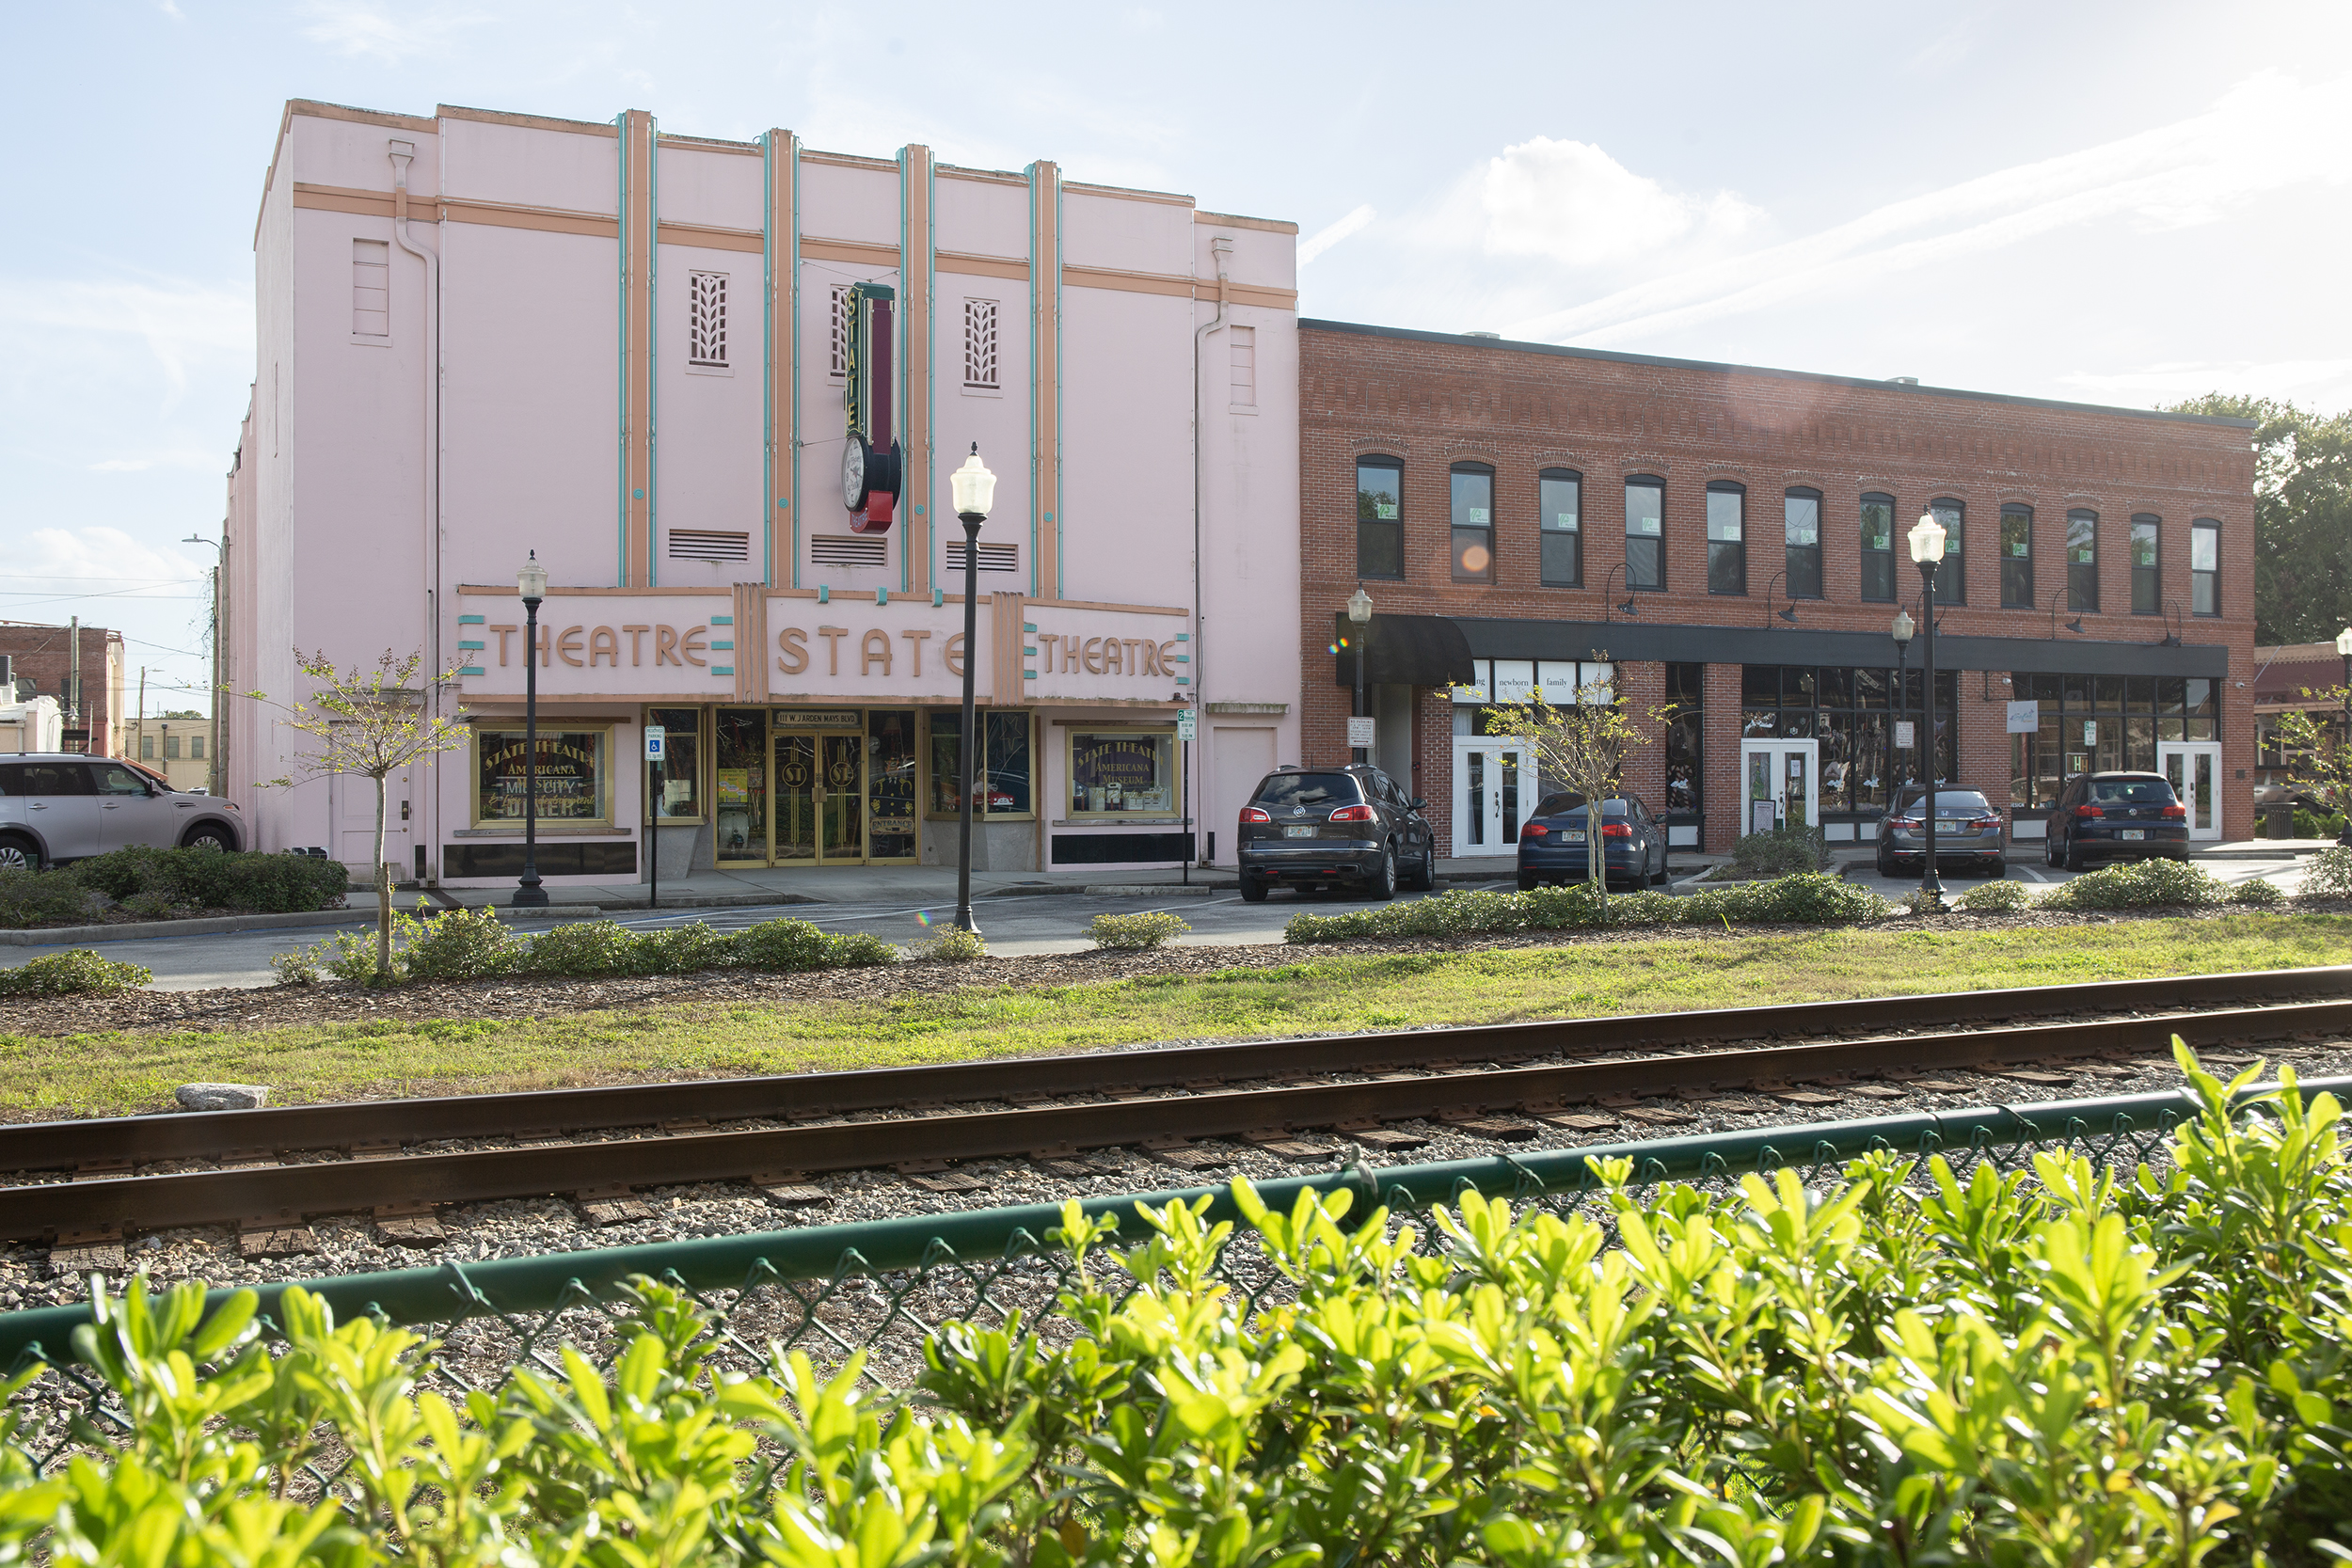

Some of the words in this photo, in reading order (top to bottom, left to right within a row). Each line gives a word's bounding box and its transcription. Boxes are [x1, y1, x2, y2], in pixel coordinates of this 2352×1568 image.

[848, 292, 857, 426] STATE
[488, 624, 707, 667] THEATRE
[777, 626, 966, 678] STATE
[1038, 632, 1176, 676] THEATRE
[1499, 678, 1529, 687] newborn
[1546, 677, 1568, 689] family
[1179, 711, 1184, 721] 2
[485, 740, 528, 771] STATE
[1077, 742, 1112, 768] STATE
[508, 762, 577, 775] AMRICANA
[1095, 762, 1151, 772] AMERICANA
[785, 767, 803, 783] ST
[1103, 774, 1144, 785] MUSEUM
[516, 778, 568, 789] MSEUM
[544, 781, 576, 794] CITY
[871, 819, 913, 831] ENTRANCE
